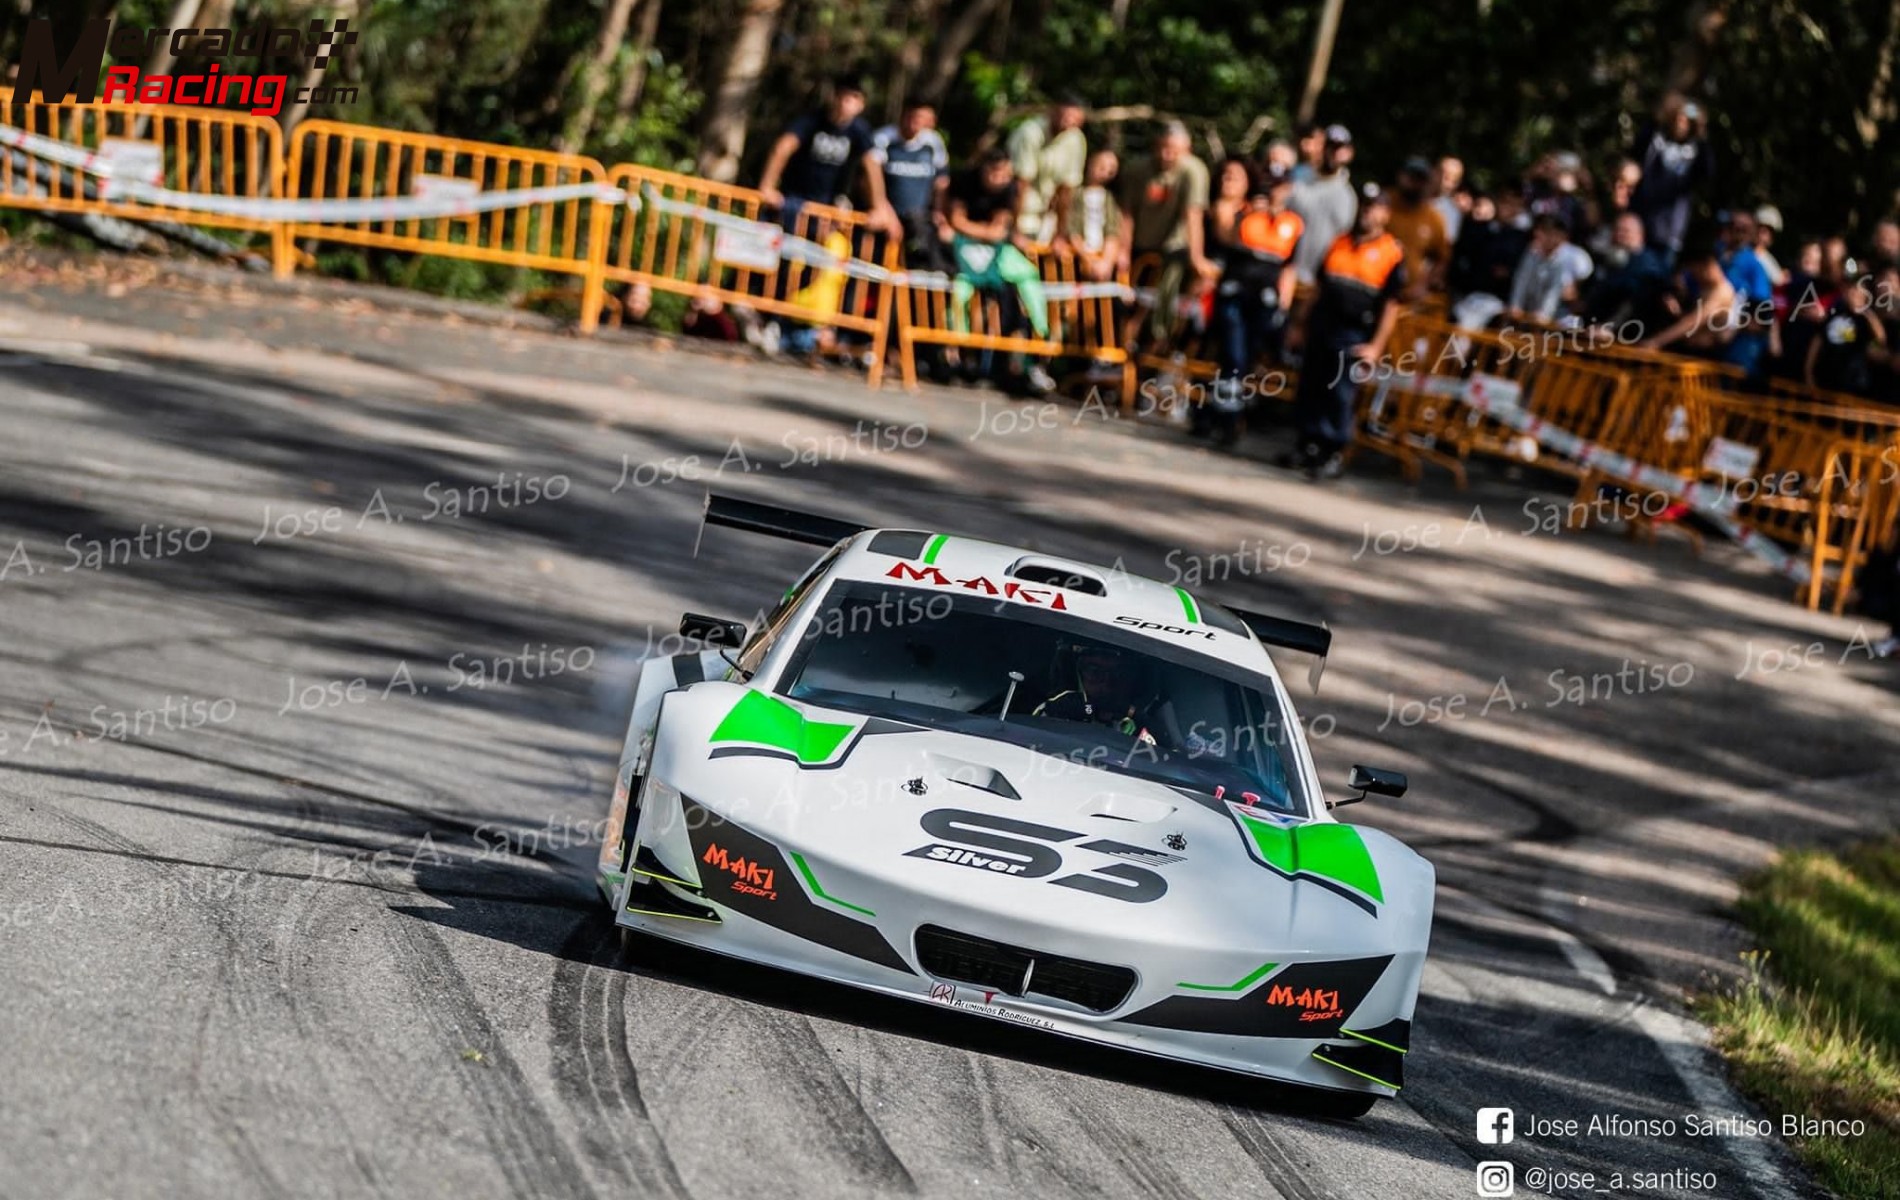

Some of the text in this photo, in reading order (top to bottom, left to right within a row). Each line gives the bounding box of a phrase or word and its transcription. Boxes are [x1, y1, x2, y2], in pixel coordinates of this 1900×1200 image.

[886, 562, 1067, 610] MAKI
[1113, 615, 1216, 640] Sport
[703, 843, 774, 889] MAKI
[926, 846, 1026, 875] Silver
[731, 881, 777, 900] Sport
[1267, 984, 1338, 1011] MAKI
[1299, 1009, 1343, 1022] Sport
